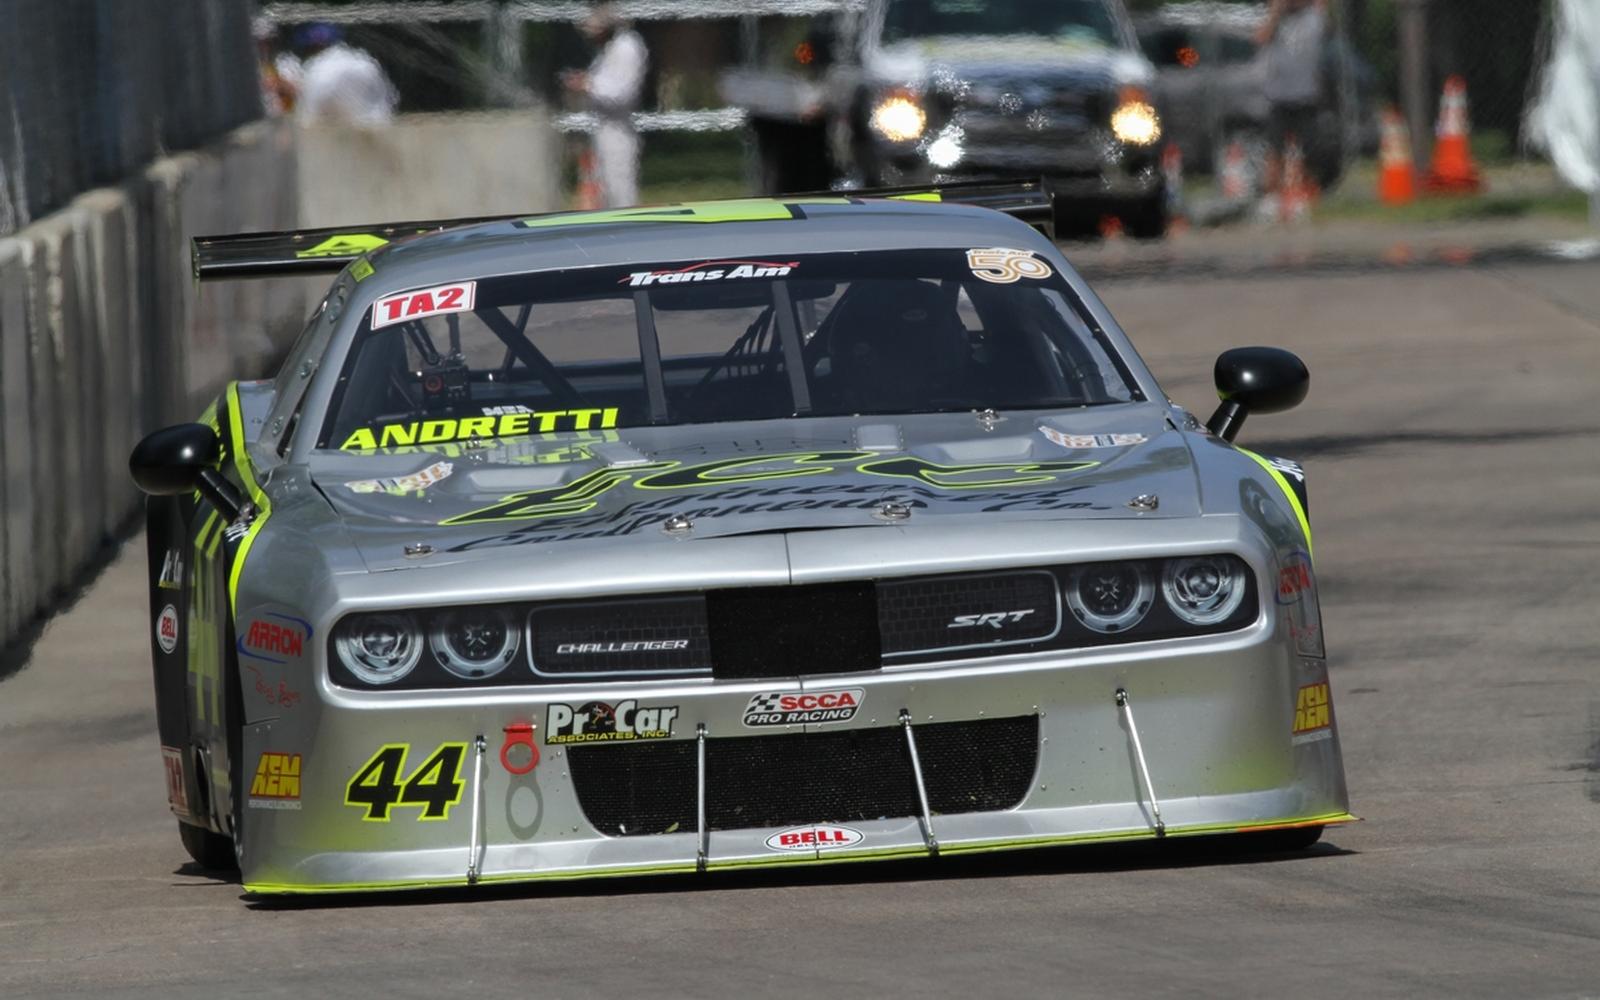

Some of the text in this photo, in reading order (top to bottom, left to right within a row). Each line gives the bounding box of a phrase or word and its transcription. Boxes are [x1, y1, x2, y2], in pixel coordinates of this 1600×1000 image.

[629, 264, 792, 287] Trans Am
[968, 253, 1053, 284] 50
[383, 287, 465, 321] TA2
[340, 408, 619, 451] ANDRETTI
[947, 608, 1035, 629] SRT
[246, 619, 303, 657] ARROW
[556, 639, 689, 654] CHALLENGER
[780, 692, 856, 711] SCCA
[746, 708, 853, 724] PRO RACING
[641, 728, 670, 739] INC.
[249, 752, 302, 800] AEM
[344, 741, 469, 822] 44
[779, 830, 850, 846] BELL
